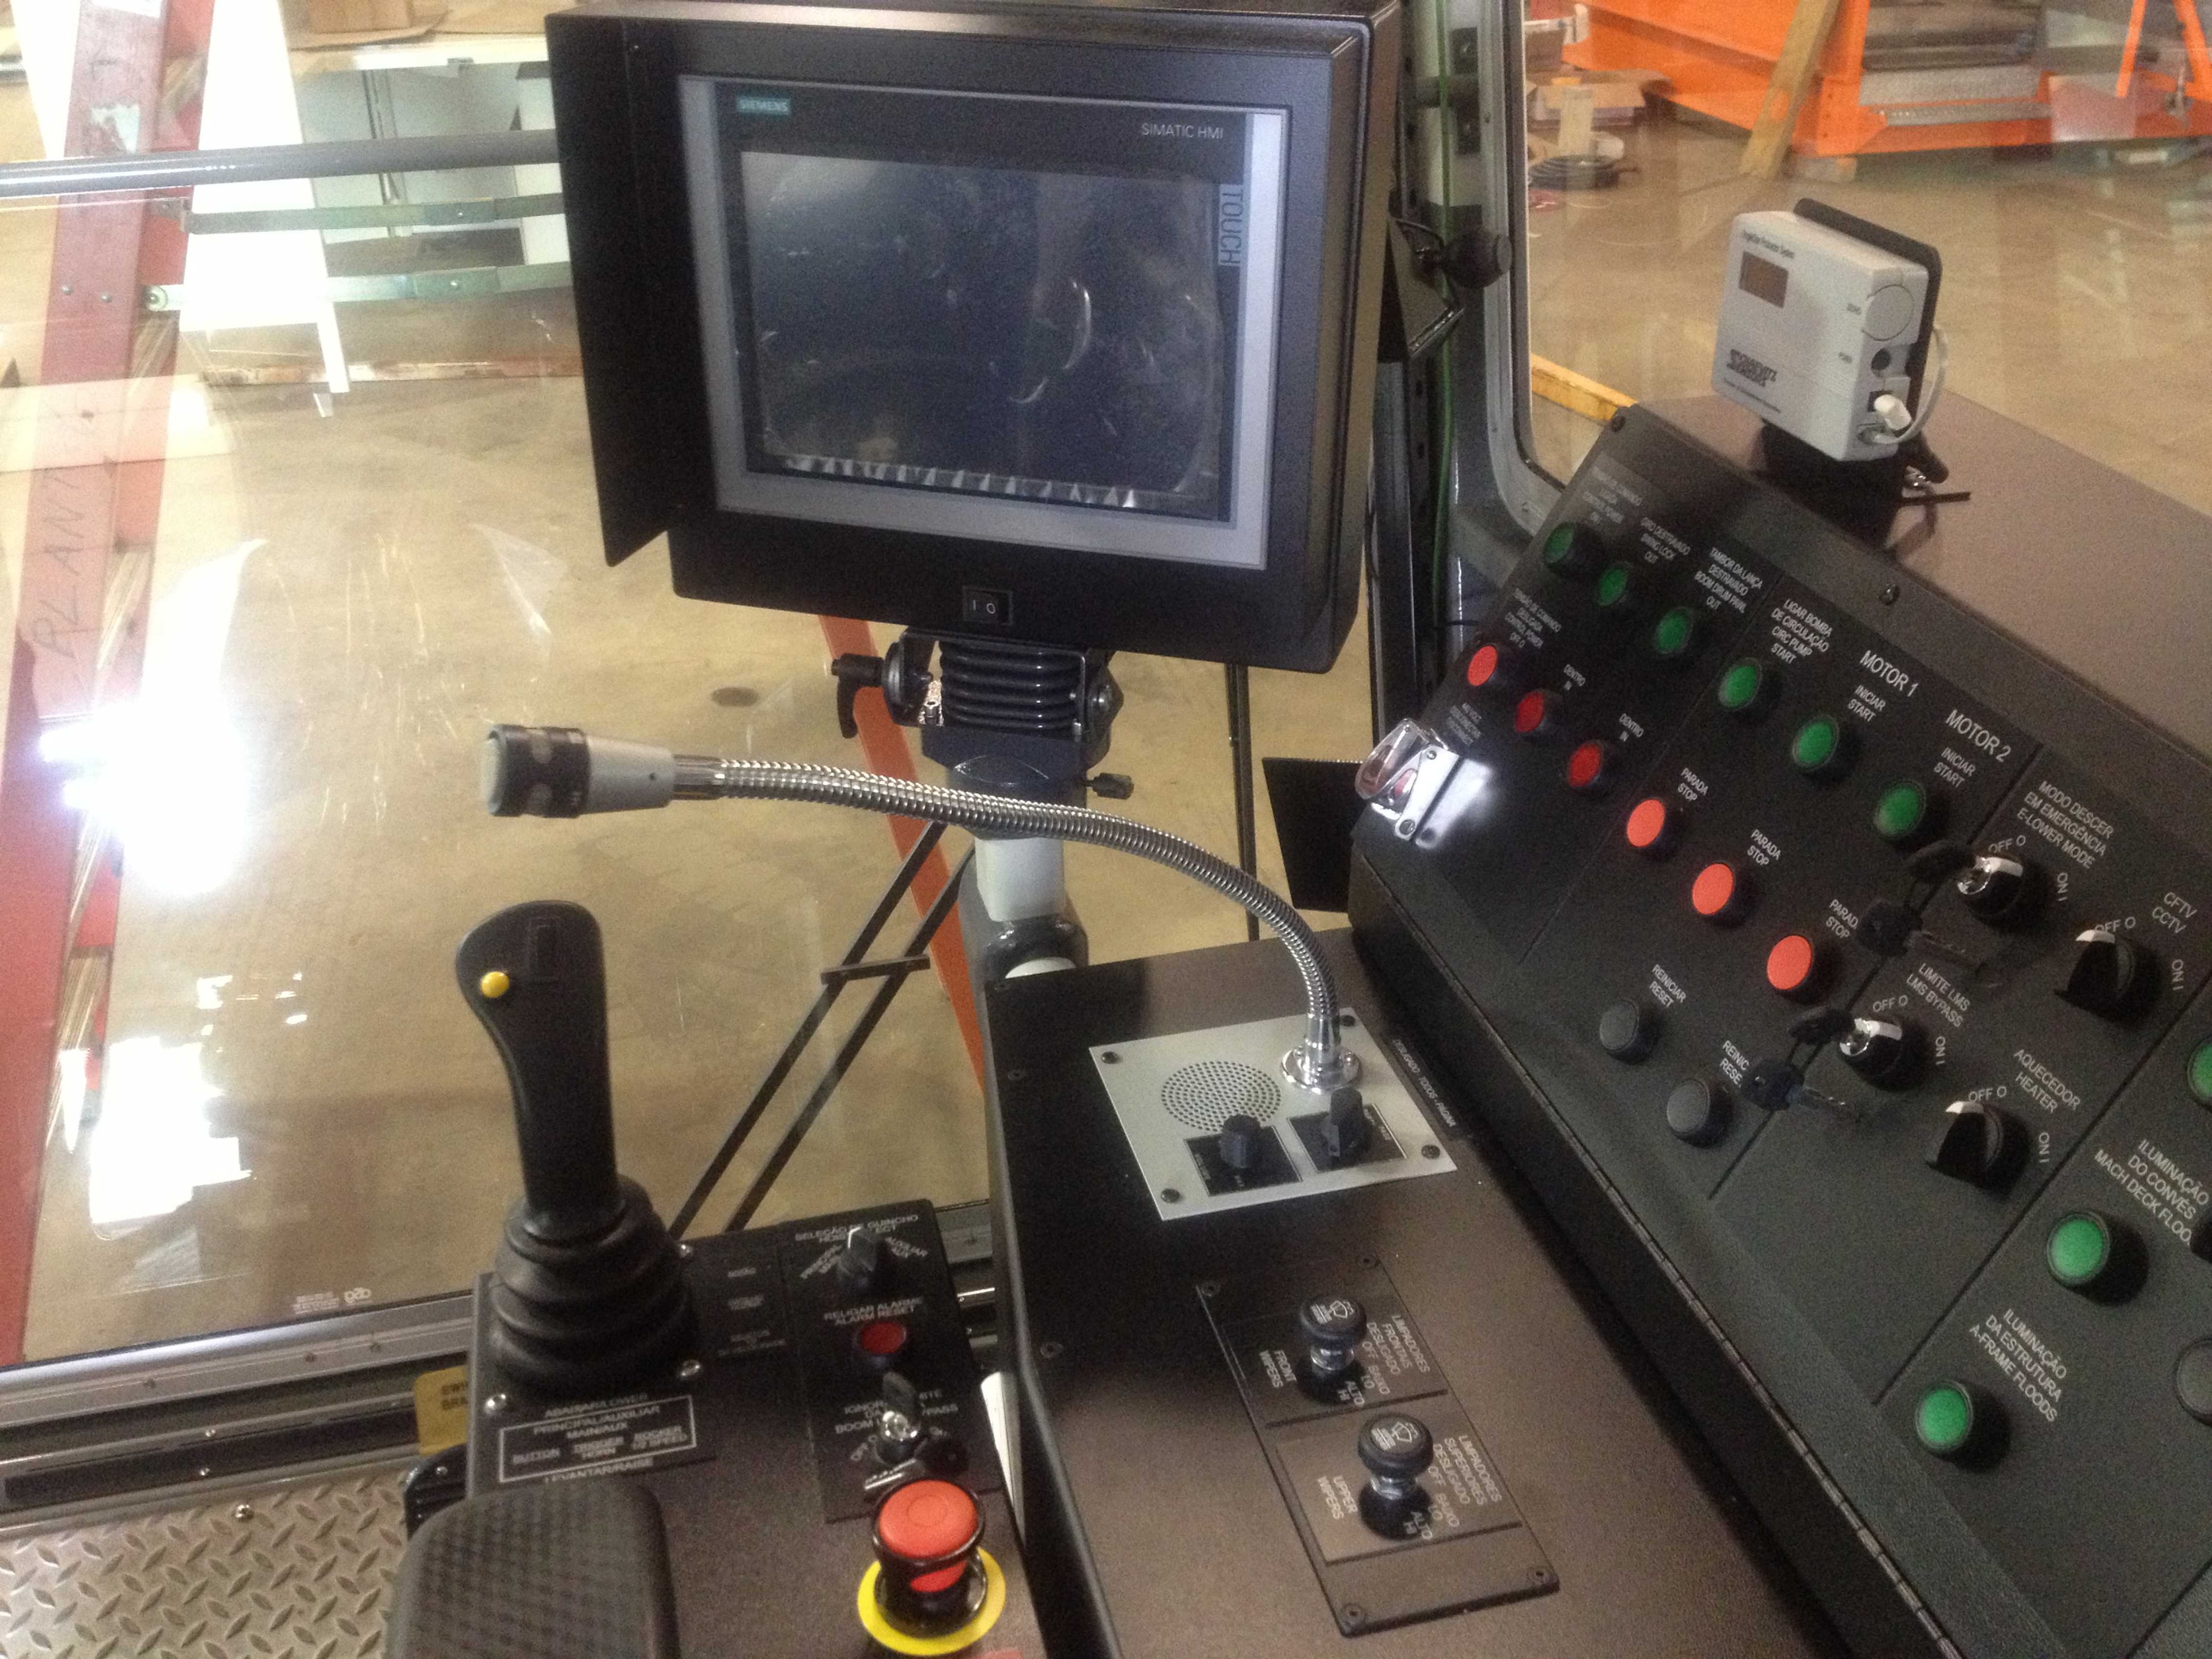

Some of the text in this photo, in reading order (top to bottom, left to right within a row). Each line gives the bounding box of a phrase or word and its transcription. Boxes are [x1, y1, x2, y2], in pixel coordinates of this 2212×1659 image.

[1141, 122, 1224, 139] SIMATIC HMI
[1220, 188, 1244, 265] TOUCH
[1644, 551, 1658, 563] OUT
[1710, 547, 1735, 569] TAMBOR
[1733, 563, 1743, 575] DA
[1694, 570, 1714, 589] BOOM
[1711, 582, 1729, 601] DRUM
[1708, 564, 1748, 596] DESTRAVADO
[1706, 596, 1722, 609] OUT
[1771, 608, 1830, 653] DE CIRCULAÇÃO
[1783, 599, 1833, 638] LIGAR BOMBA
[1771, 642, 1797, 664] START
[1772, 626, 1813, 657] CIRC PUMP
[1563, 664, 1586, 687] DENTRO
[1860, 649, 1919, 697] MOTOR 1
[1848, 698, 1877, 722] START
[1854, 684, 1886, 711] INICIAR
[1619, 713, 1644, 738] DENTRO
[1945, 709, 2012, 763] MOTOR 2
[1933, 762, 1965, 787] START
[1941, 747, 1976, 777] INICIAR
[1677, 782, 1698, 802] STOP
[1680, 767, 1709, 797] PARADA
[2024, 791, 2044, 810] EM
[2037, 780, 2115, 839] MODO DESCER
[1750, 828, 1782, 861] PARADA
[1988, 838, 2013, 854] OFF
[2016, 807, 2096, 870] E-LOWER MODE
[1747, 845, 1770, 866] STOP
[2057, 872, 2069, 896] ON
[1829, 899, 1859, 930] PARAD
[2152, 906, 2187, 934] CCTV
[2163, 891, 2198, 919] CFTV
[1825, 916, 1851, 939] STOP
[1652, 964, 1687, 1003] REINICIAR
[1918, 963, 1971, 1012] LIMITE LMS
[2171, 959, 2184, 985] ON
[1649, 981, 1674, 1007] RESET
[1873, 997, 1895, 1013] OFF
[1906, 974, 1964, 1028] LMS BYPASS
[1722, 1040, 1749, 1071] REINIC
[1935, 1036, 1946, 1059] ON
[1719, 1058, 1743, 1088] RESE
[2014, 1048, 2081, 1111] AQUECEDOR
[1968, 1088, 1994, 1103] OFF
[2015, 1071, 2058, 1114] HEATER
[2038, 1131, 2050, 1156] ON
[2128, 1154, 2148, 1176] DO
[2138, 1138, 2210, 1205] ILUMINAÇÃO
[2094, 1149, 2192, 1246] MACH DECK FLOO
[1362, 1341, 1378, 1359] OFF
[1366, 1322, 1401, 1375] DESLIGADO
[1382, 1323, 1412, 1368] FRONTAIS
[1391, 1315, 1430, 1373] LIMPADORES
[1986, 1315, 2062, 1403] DA ESTRUTURA
[2003, 1308, 2067, 1380] ILUMINAÇÃO
[1259, 1349, 1283, 1388] WIPERS
[1273, 1350, 1297, 1382] FRONT
[1969, 1324, 2058, 1422] A-FRAME FLOODS
[1344, 1381, 1365, 1406] ALTO
[1433, 1443, 1470, 1504] DESLIGADO
[1444, 1437, 1488, 1505] SUPERIORES
[1458, 1435, 1502, 1502] LIMPADORES
[1317, 1476, 1344, 1520] WIPERS
[1333, 1475, 1358, 1514] UPPER
[1410, 1511, 1433, 1540] ALTO
